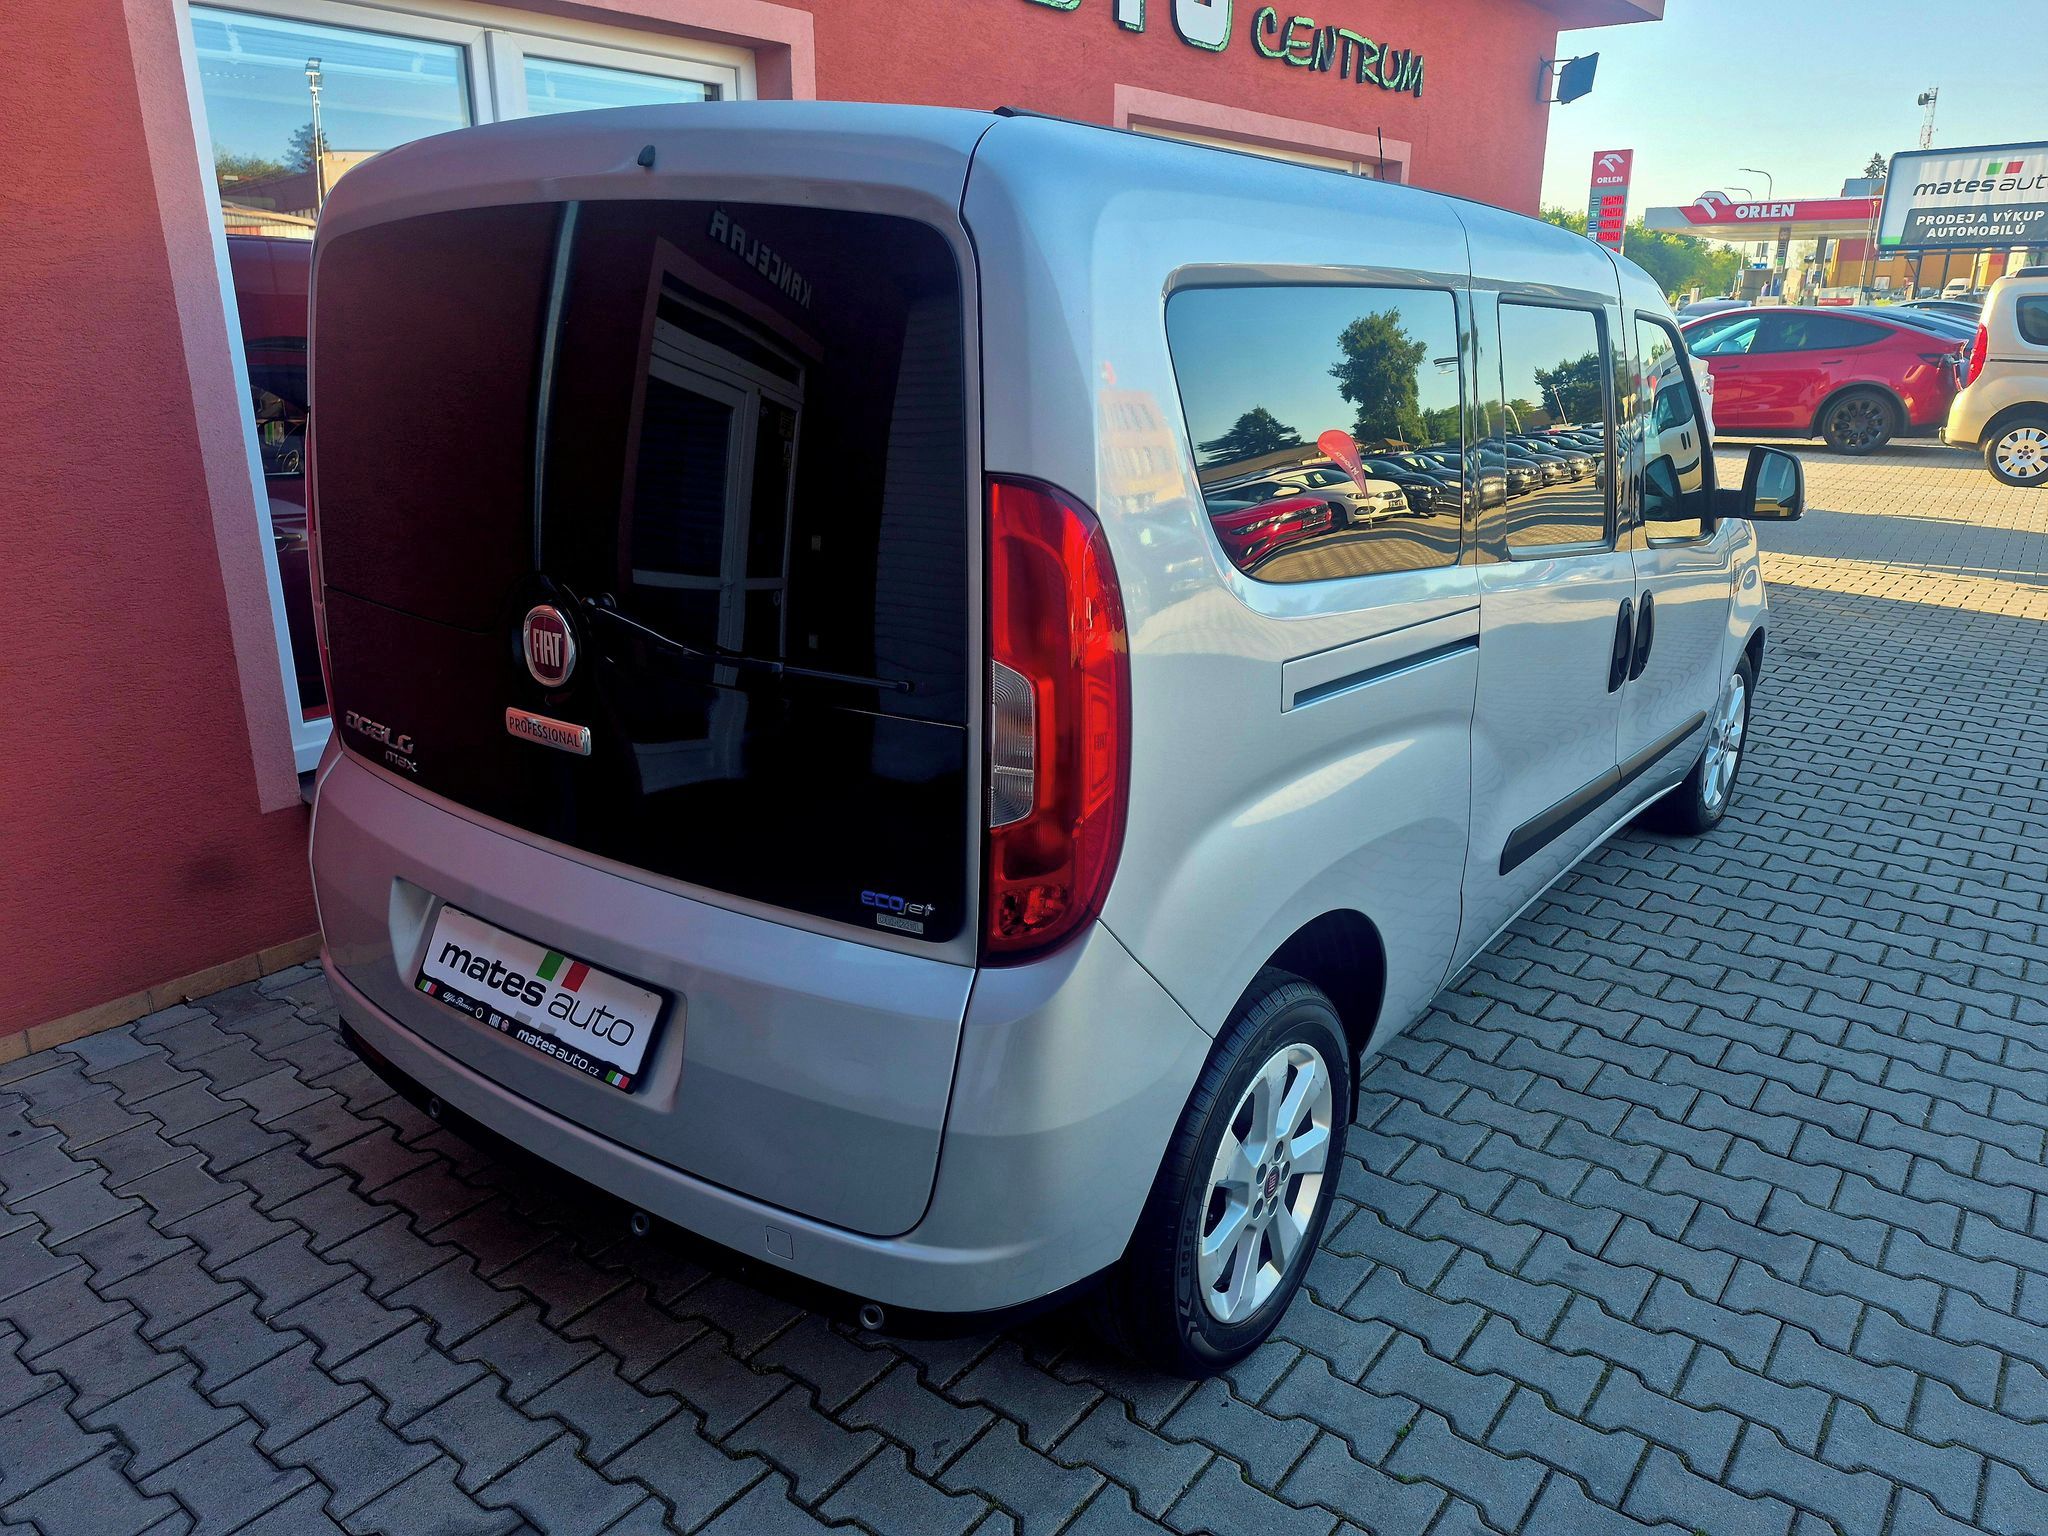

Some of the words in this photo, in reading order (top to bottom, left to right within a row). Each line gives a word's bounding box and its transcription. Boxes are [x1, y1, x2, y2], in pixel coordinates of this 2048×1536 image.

[1251, 6, 1425, 98] CENTRUM
[1597, 175, 1623, 184] ORLEN
[1912, 178, 1997, 197] mates
[1998, 173, 2048, 192] aut
[1735, 203, 1795, 219] ORLEN
[1916, 213, 1975, 226] PRODEJ
[1978, 213, 1988, 223] A
[1993, 209, 2045, 223] VÝKUP
[1926, 222, 2026, 238] AUTOMOBILŮ
[532, 627, 562, 668] FIAT
[508, 716, 580, 748] PROFESSIONAL
[438, 941, 548, 1008] mates
[547, 992, 635, 1047] auto
